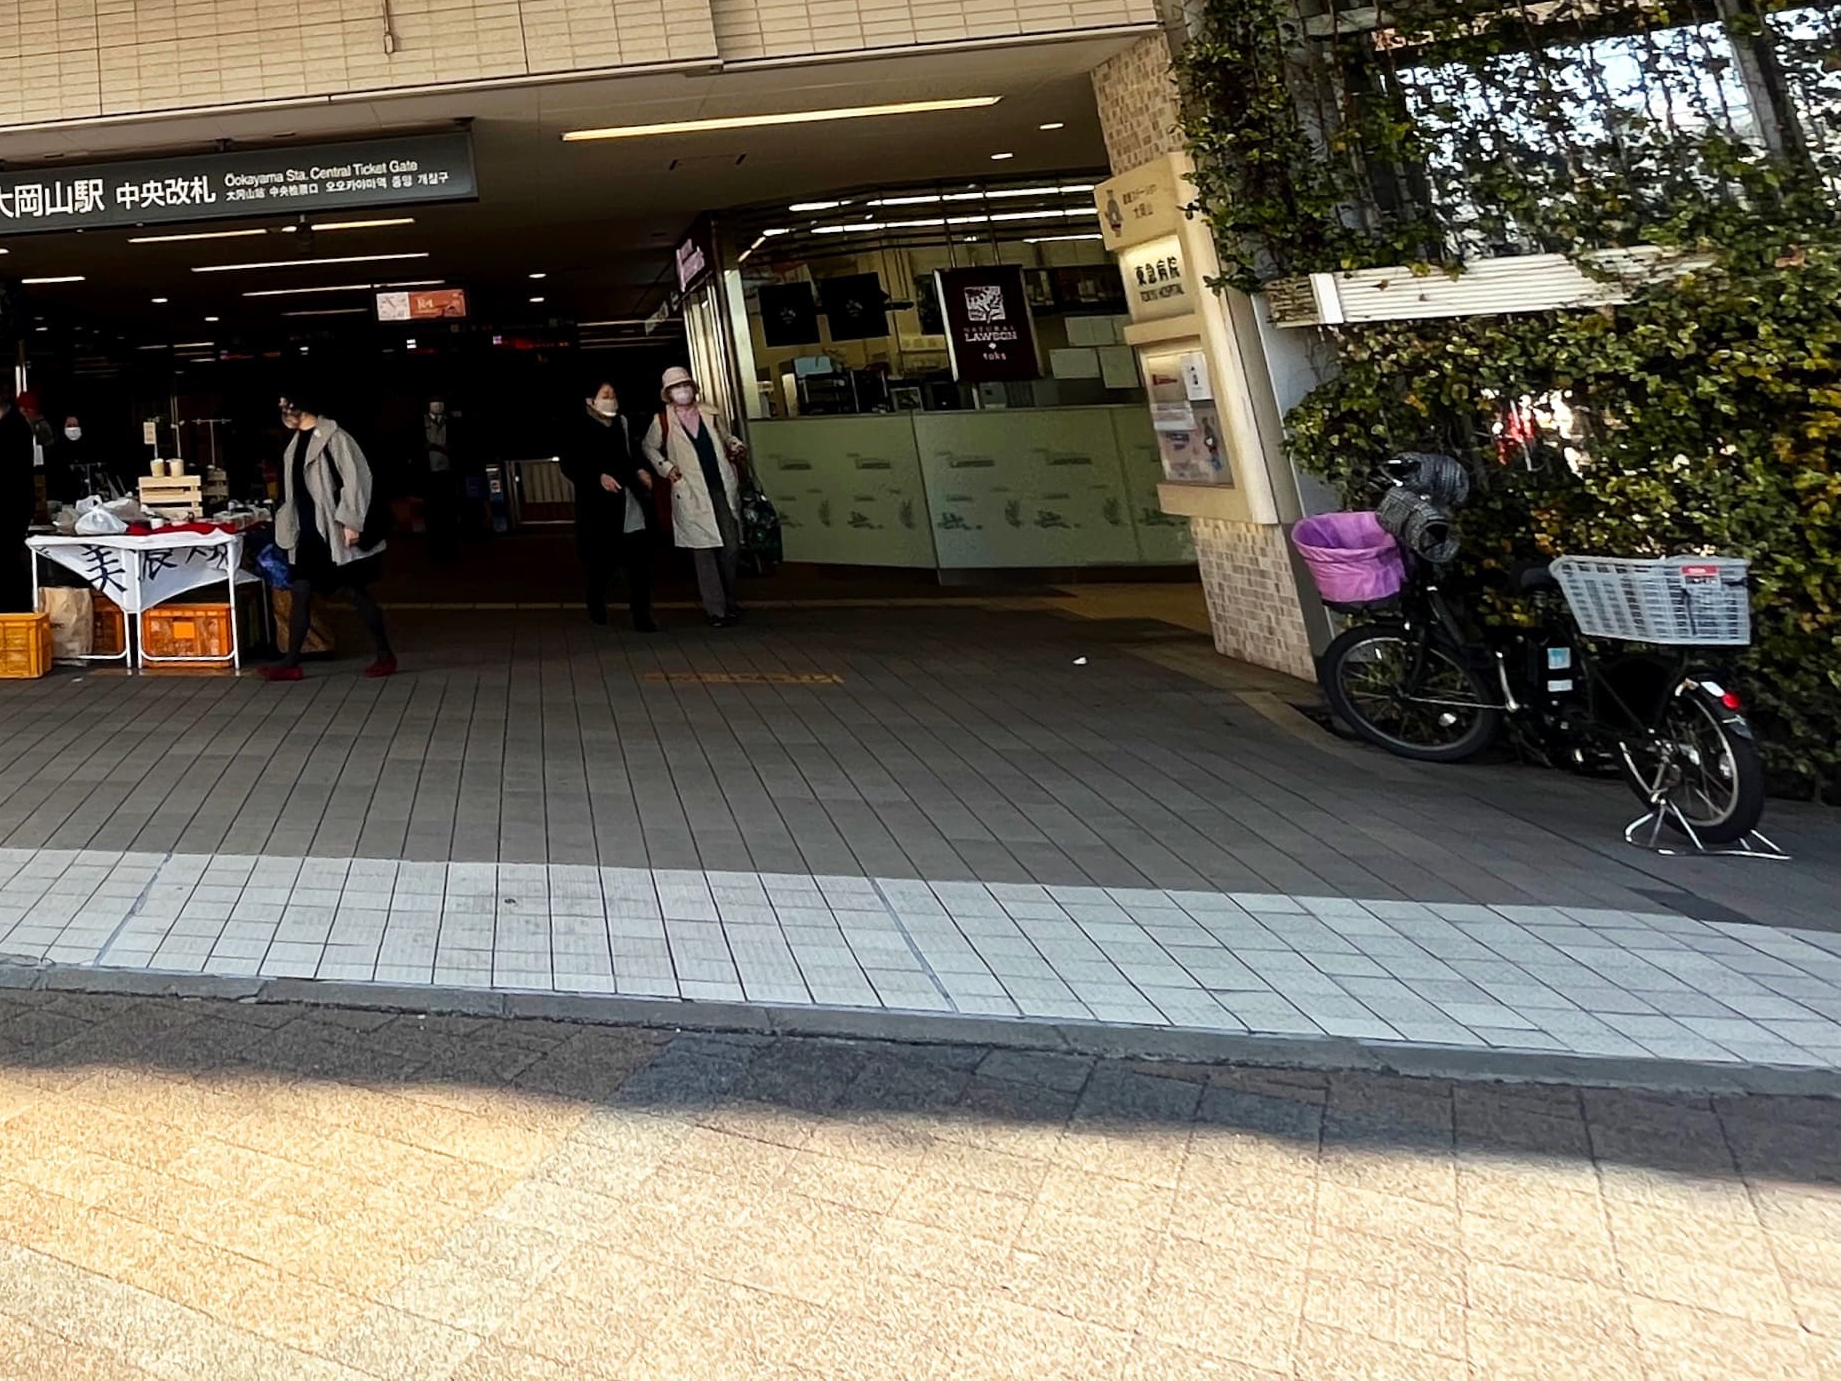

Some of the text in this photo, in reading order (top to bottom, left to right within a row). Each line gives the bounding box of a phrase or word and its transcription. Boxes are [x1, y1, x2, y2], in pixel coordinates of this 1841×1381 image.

[285, 169, 309, 182] Sta.
[309, 164, 352, 180] Central
[352, 162, 387, 176] Ticket
[388, 159, 419, 174] Gate
[115, 175, 217, 210] 中央改札
[1134, 256, 1181, 287] 東急病院
[964, 330, 1018, 342] LAWSON
